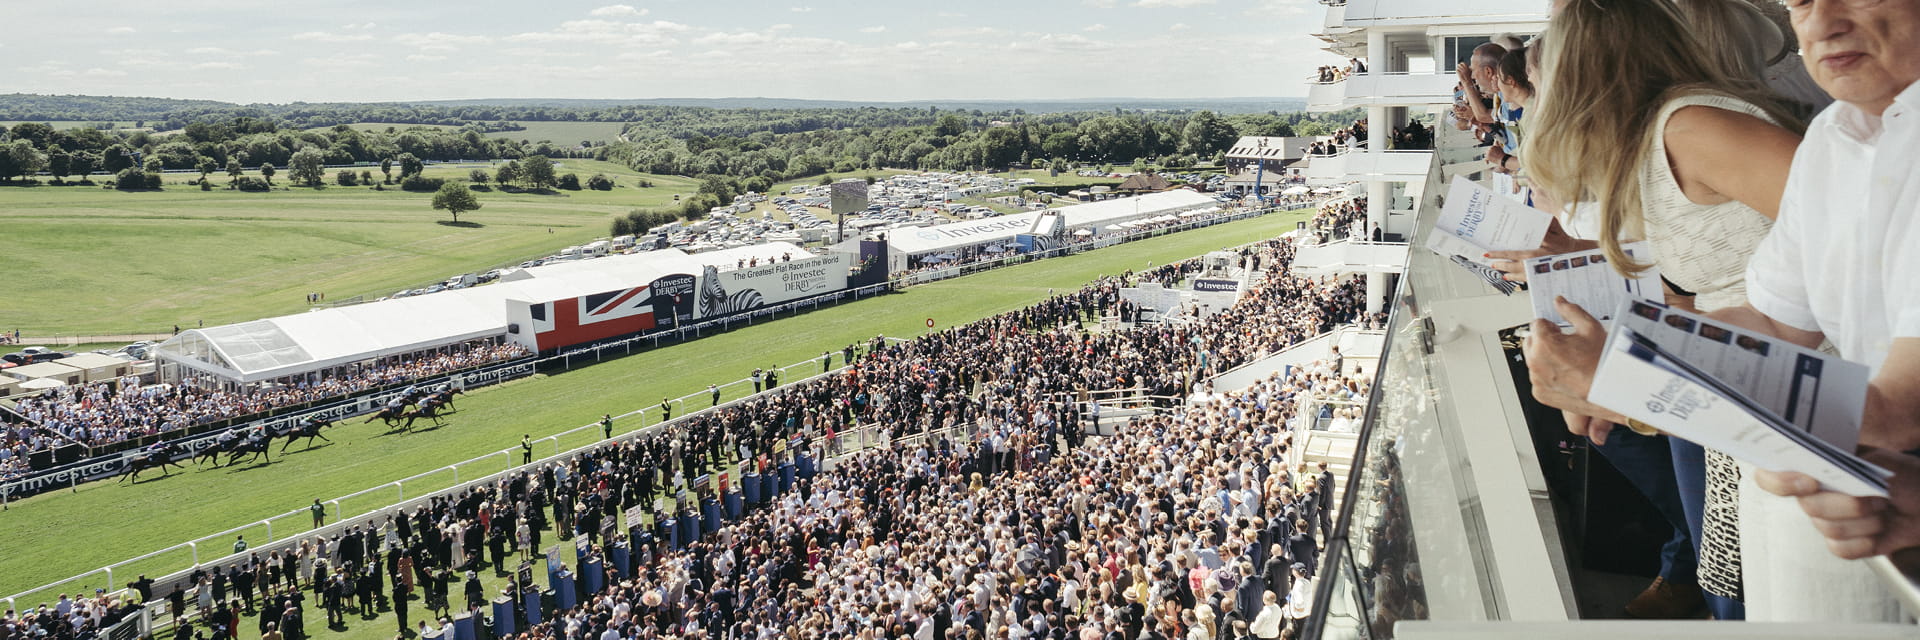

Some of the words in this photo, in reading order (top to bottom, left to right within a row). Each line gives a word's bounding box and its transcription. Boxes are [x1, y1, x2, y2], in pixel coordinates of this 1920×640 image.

[1460, 188, 1481, 228] Investec
[937, 217, 1032, 240] Investec
[733, 273, 746, 281] The
[747, 268, 775, 279] Greatest
[775, 265, 788, 274] Flat
[788, 262, 804, 272] Race
[804, 260, 811, 268] in
[811, 259, 822, 268] the
[822, 256, 839, 265] World
[790, 268, 826, 281] Investec
[660, 276, 693, 288] Investec
[785, 280, 809, 291] DERBY
[1203, 282, 1238, 290] Investec
[655, 286, 678, 297] DERBY
[479, 363, 530, 383] Investec
